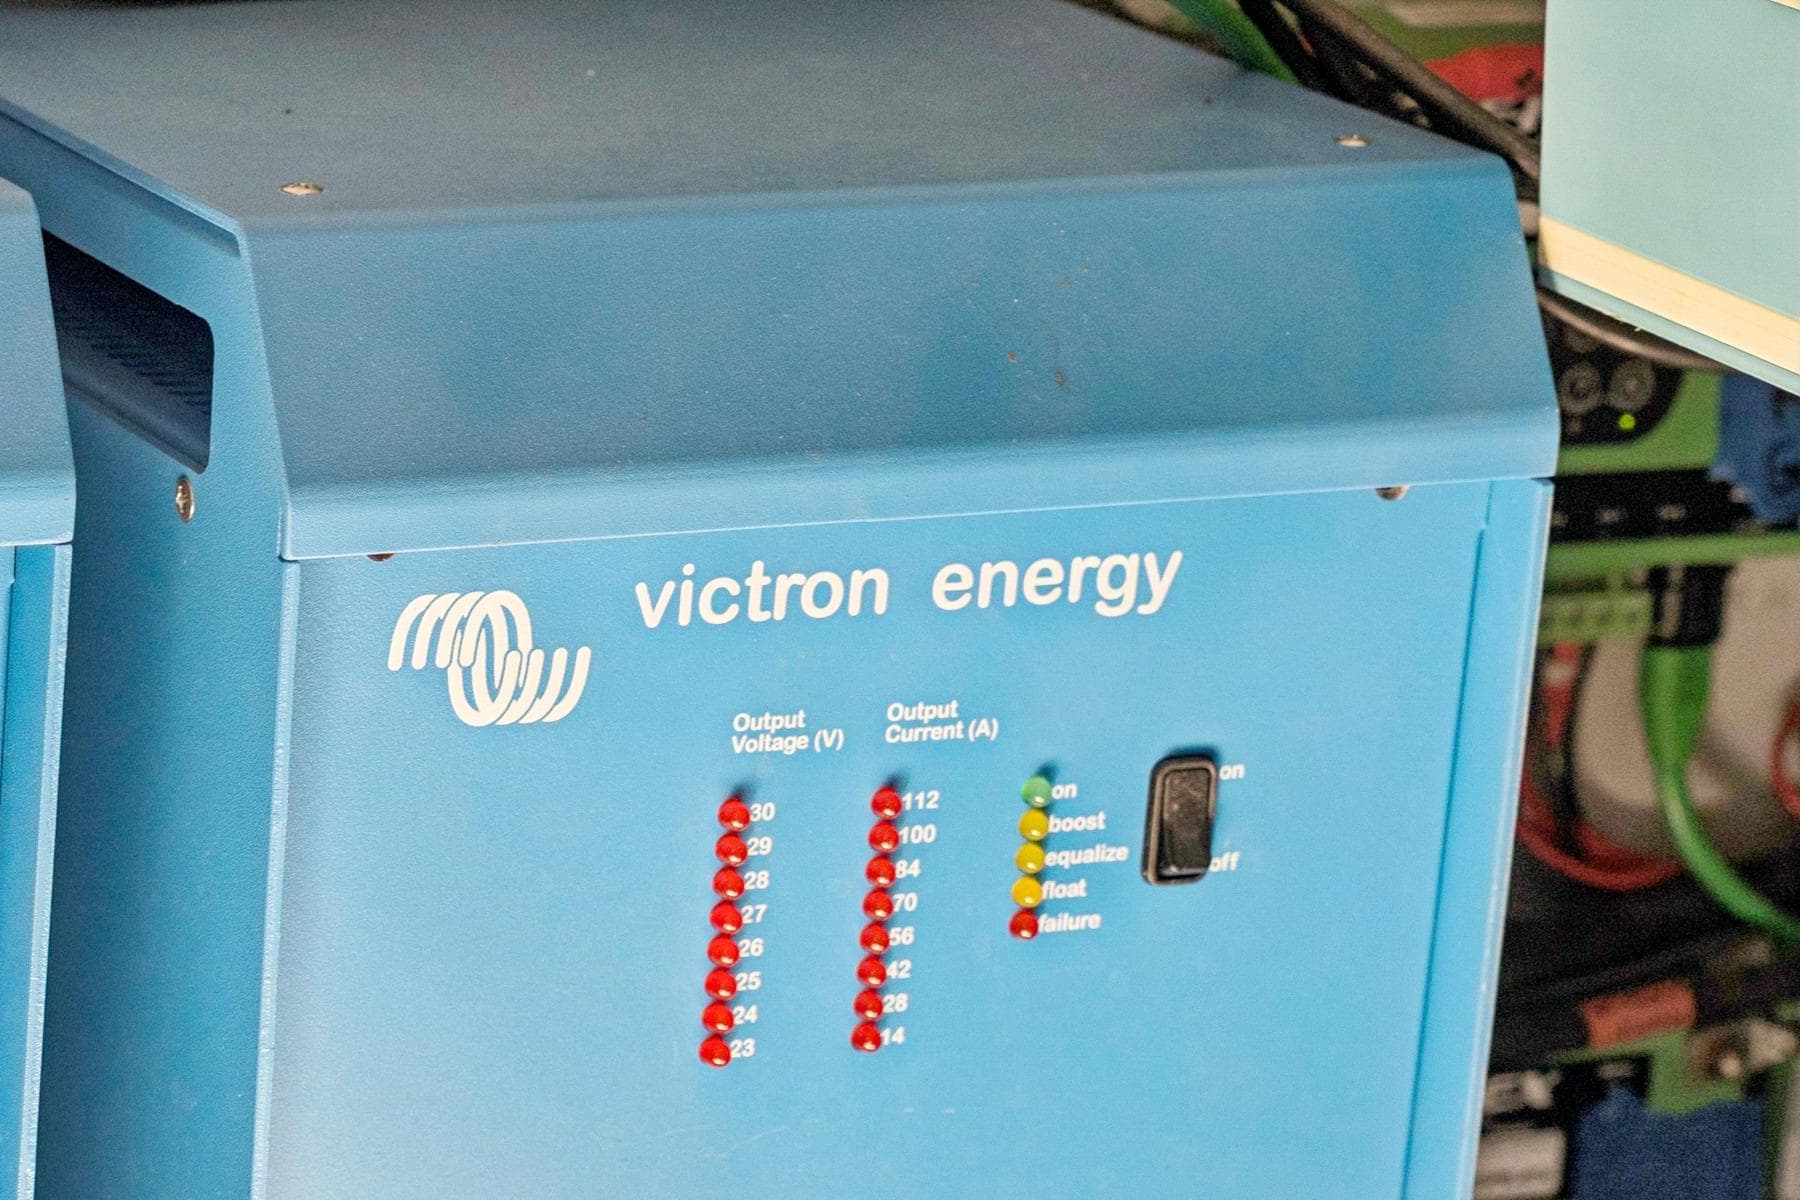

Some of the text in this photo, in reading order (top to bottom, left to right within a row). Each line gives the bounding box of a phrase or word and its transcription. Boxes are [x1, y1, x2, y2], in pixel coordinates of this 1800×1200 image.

[634, 550, 1183, 629] victron energy
[732, 709, 806, 734] Output
[886, 699, 963, 726] Output
[731, 728, 845, 755] Voltage (V)
[884, 718, 999, 744] Current (A)
[1219, 763, 1246, 781] on
[901, 790, 940, 811] 112
[1051, 783, 1078, 800] on
[750, 802, 776, 822] 30
[1048, 811, 1106, 833] boost
[898, 823, 937, 845] 100
[747, 836, 773, 856] 29
[1045, 843, 1129, 869] equalize
[895, 858, 921, 879] 84
[1209, 851, 1241, 873] off
[744, 870, 770, 890] 28
[1042, 878, 1087, 900] float
[892, 892, 918, 913] 70
[741, 903, 768, 924] 27
[1038, 912, 1102, 933] failure
[889, 926, 915, 946] 56
[738, 937, 764, 958] 26
[886, 959, 912, 979] 42
[735, 971, 761, 992] 25
[883, 992, 909, 1013] 28
[733, 1004, 758, 1026] 24
[880, 1026, 905, 1046] 14
[730, 1038, 756, 1059] 23
